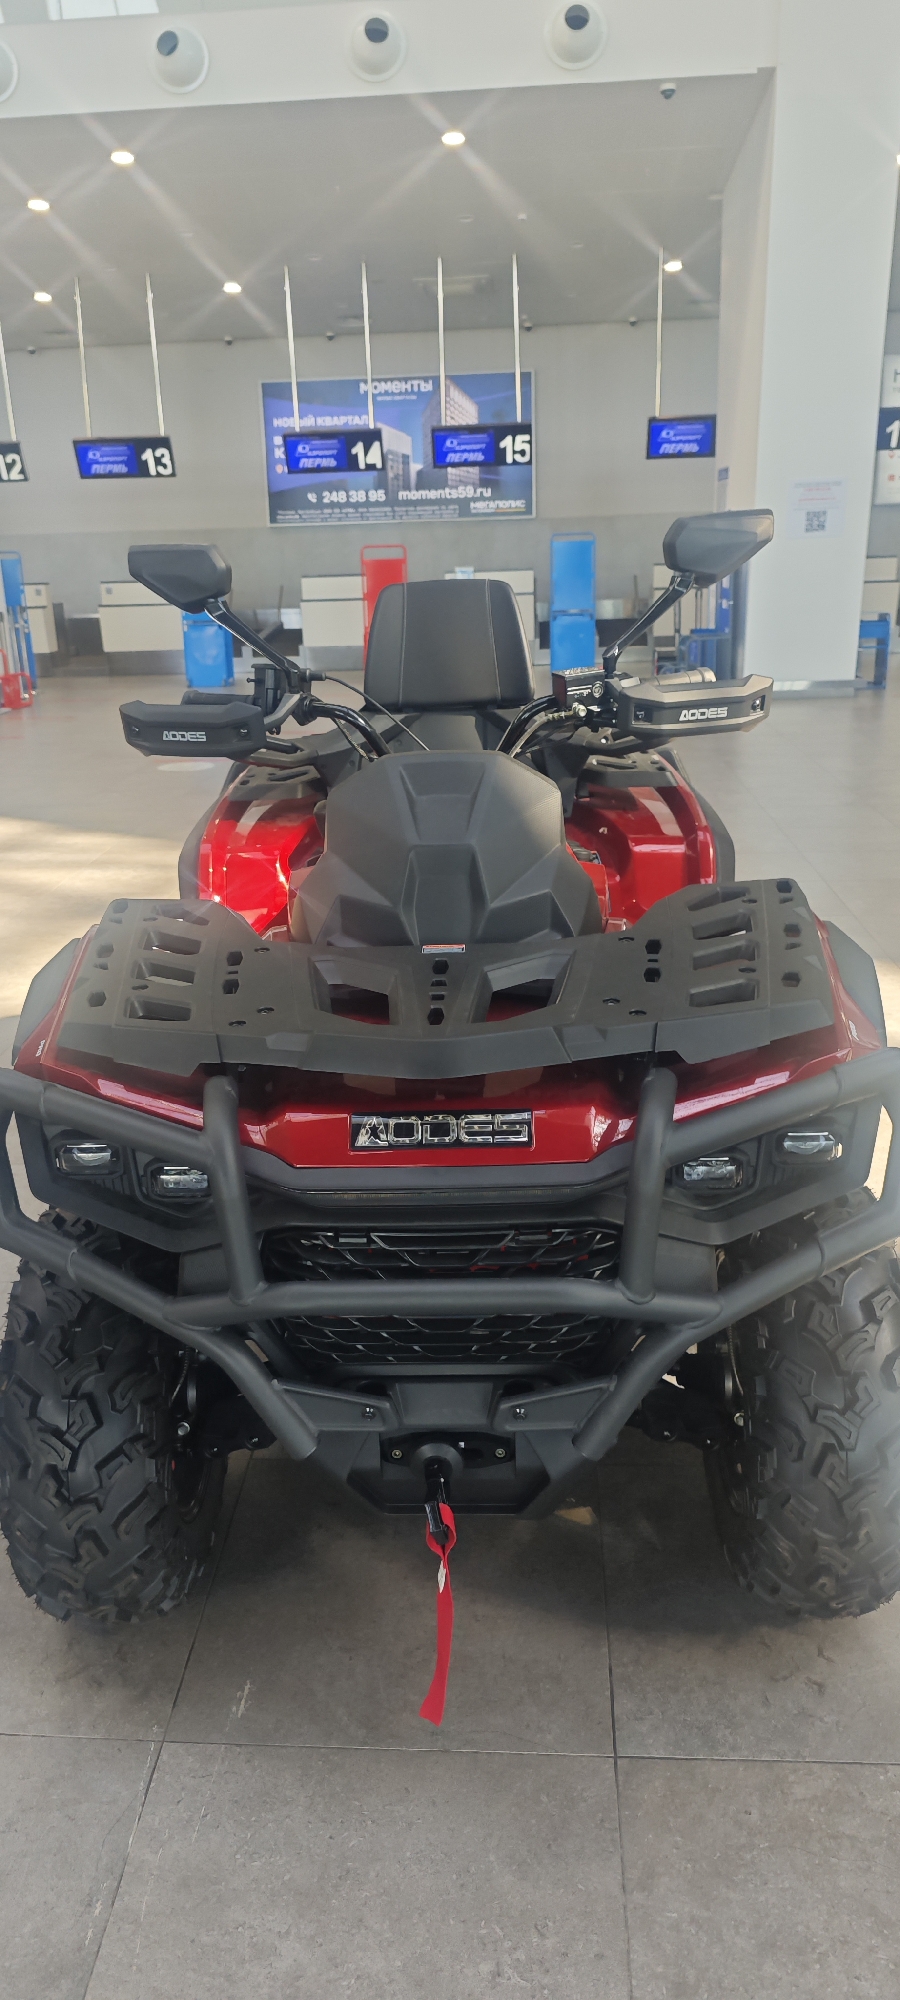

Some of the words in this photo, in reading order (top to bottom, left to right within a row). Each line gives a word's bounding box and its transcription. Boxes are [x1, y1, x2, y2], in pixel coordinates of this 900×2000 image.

[350, 440, 383, 470] 14
[499, 434, 531, 464] 15
[659, 443, 700, 454] ПЕРМЬ
[141, 447, 173, 476] 13
[299, 457, 338, 468] ПЕРМЬ
[445, 452, 485, 463] ПЕРМЬ
[0, 453, 25, 481] 12
[90, 463, 129, 474] ПЕРМЬ
[322, 490, 347, 503] 248
[348, 490, 367, 502] 38
[367, 489, 387, 502] 95
[398, 485, 492, 501] moments59.ru
[679, 706, 729, 721] AODES
[162, 730, 207, 742] AODES
[354, 1112, 529, 1147] AODES
